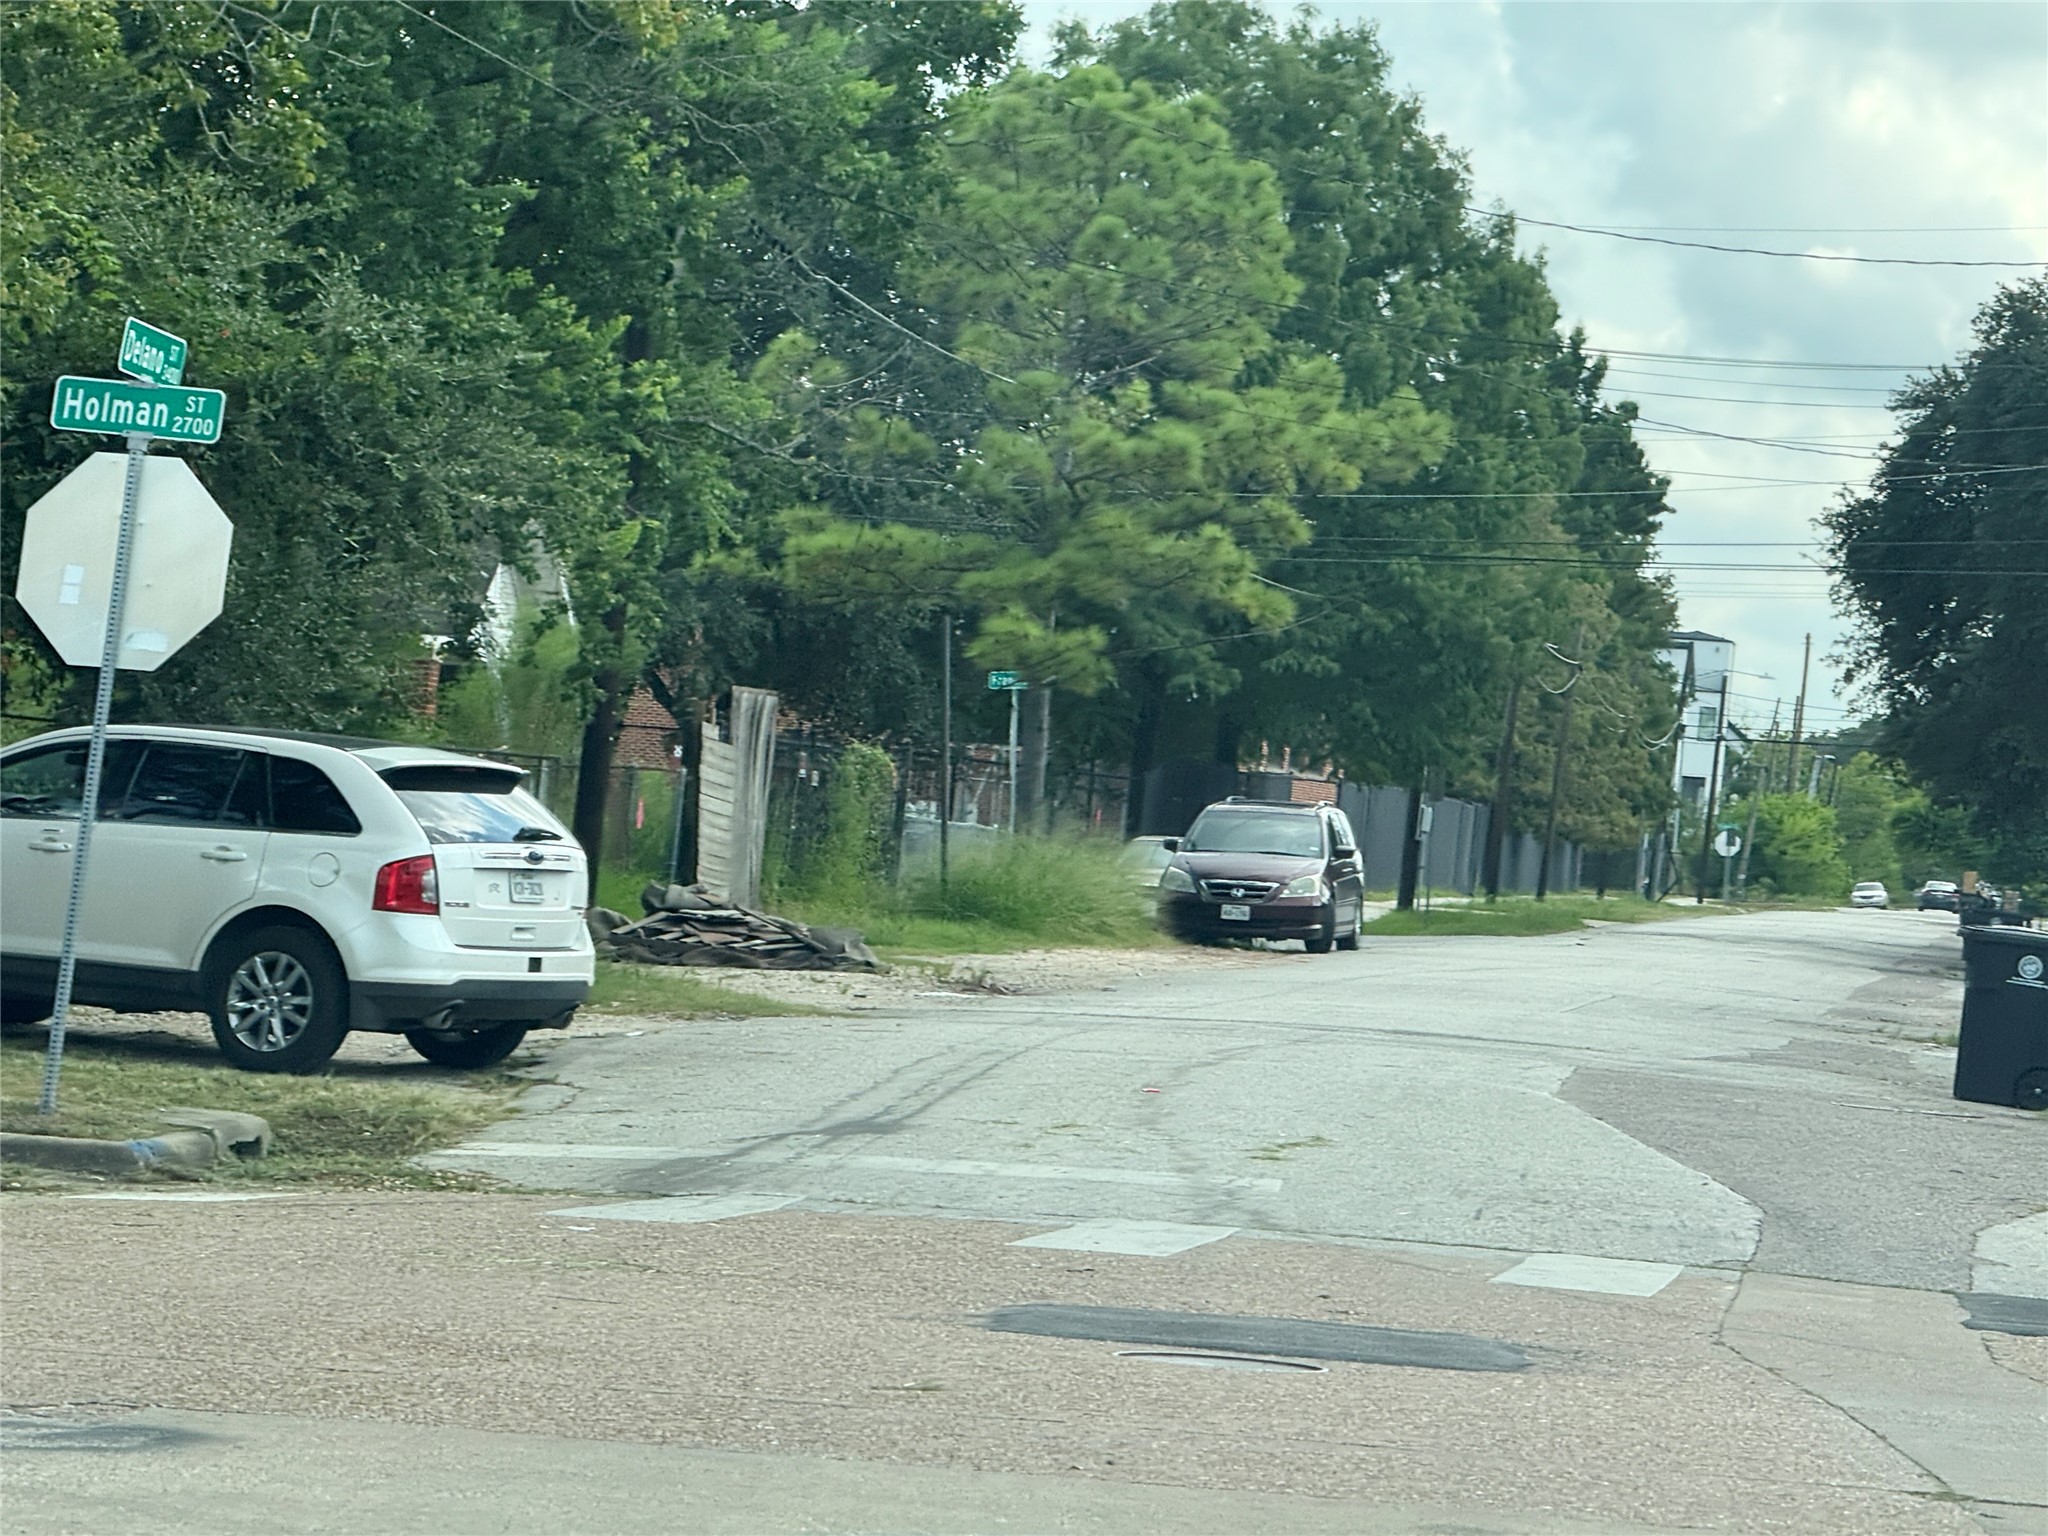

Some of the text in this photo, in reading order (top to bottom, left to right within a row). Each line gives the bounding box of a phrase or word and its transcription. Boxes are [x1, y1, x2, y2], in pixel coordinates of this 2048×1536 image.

[124, 329, 165, 374] Delano
[63, 387, 207, 427] Holman ST
[171, 416, 214, 436] 2700
